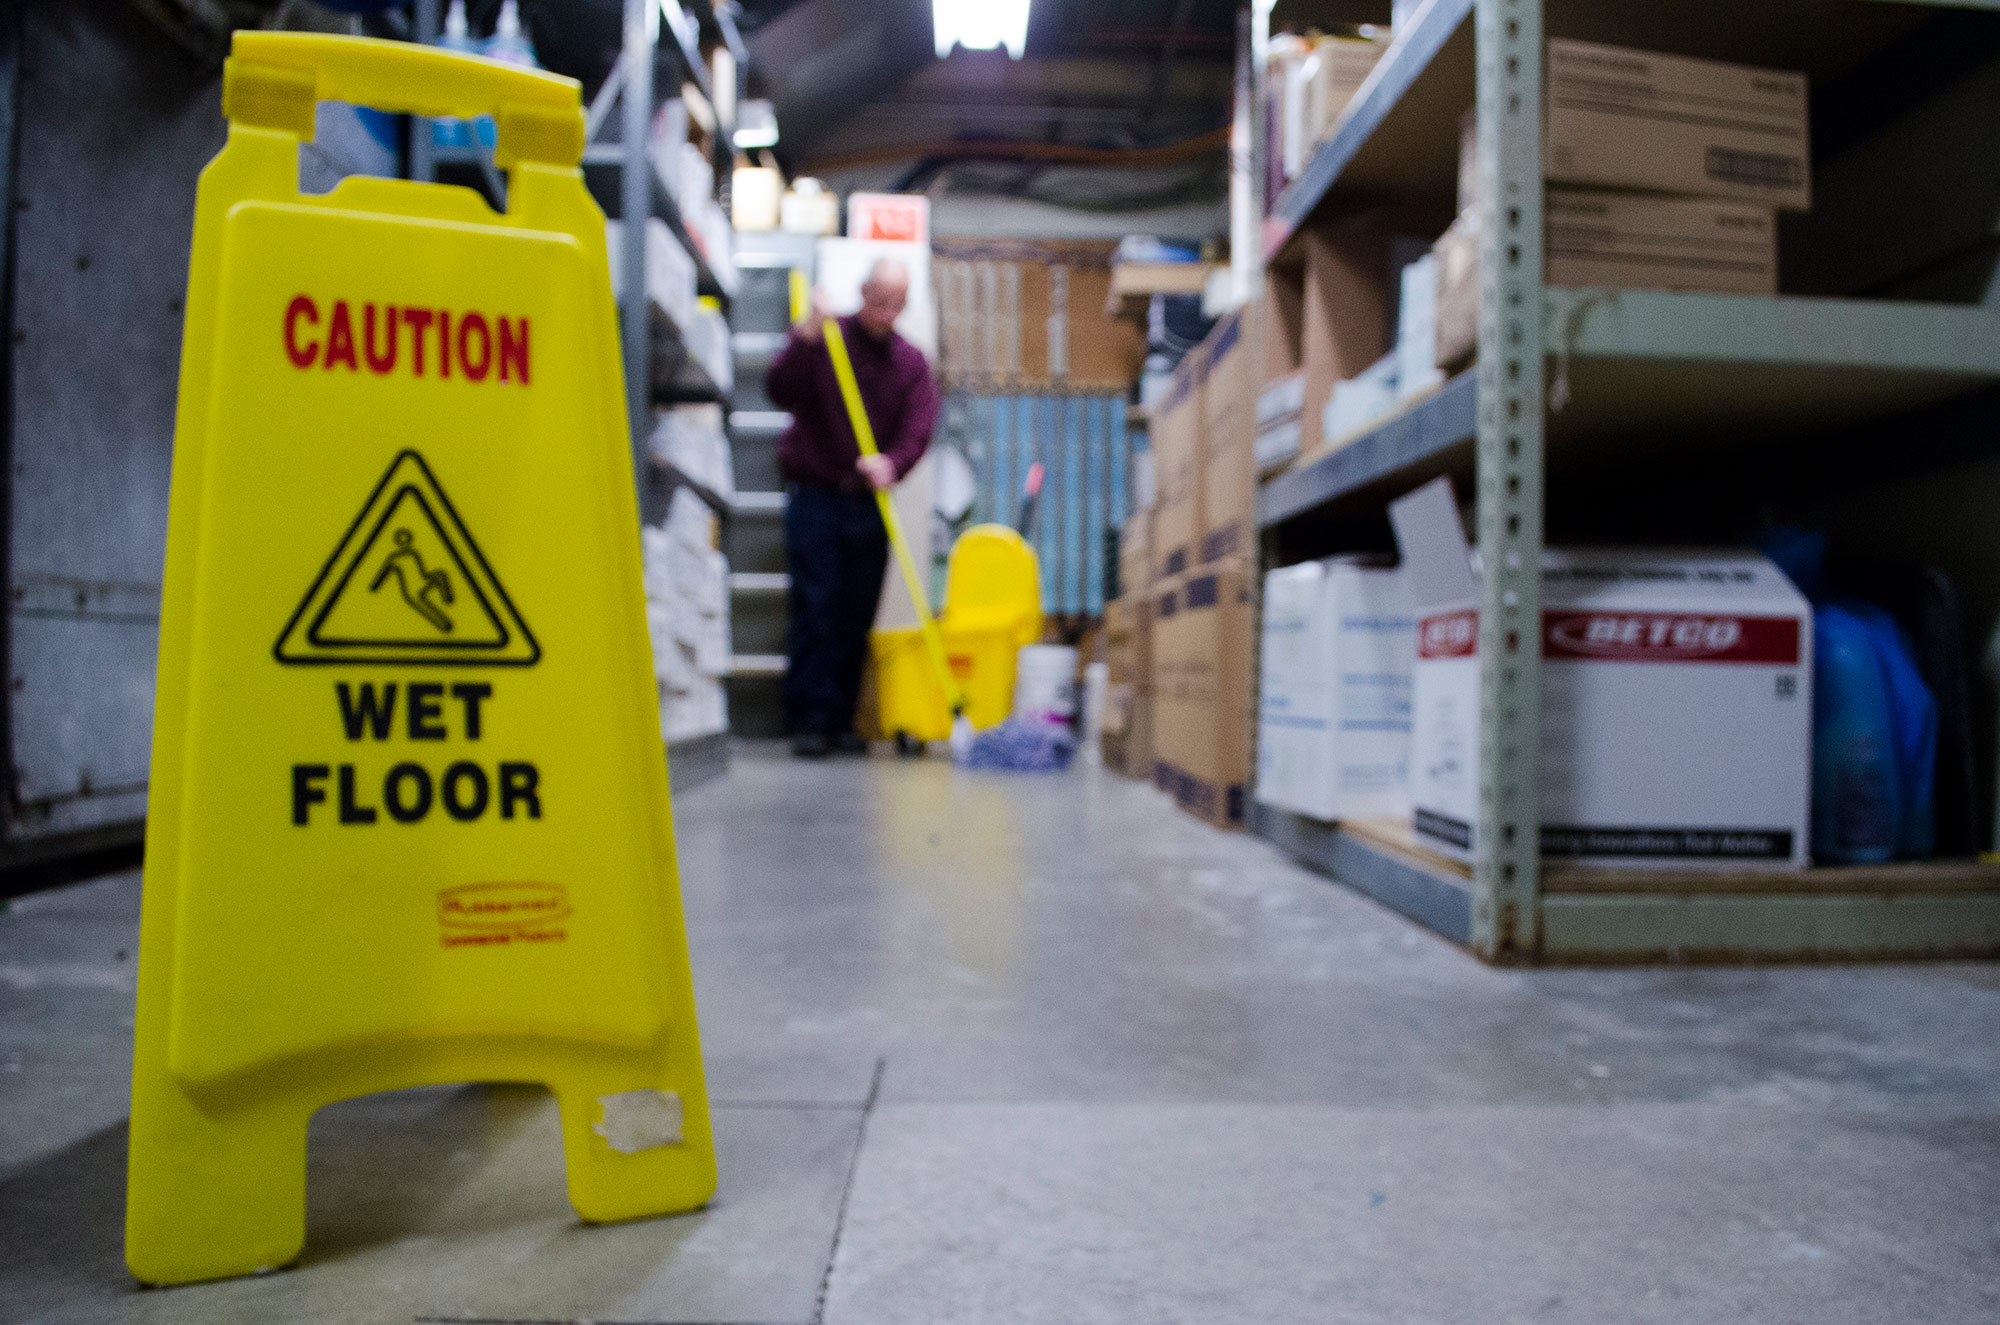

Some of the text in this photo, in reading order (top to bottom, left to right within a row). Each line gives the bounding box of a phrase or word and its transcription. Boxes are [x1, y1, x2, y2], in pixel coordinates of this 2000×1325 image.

[284, 294, 529, 386] CAUTION
[334, 682, 492, 741] WET
[292, 760, 542, 826] FLOOR
